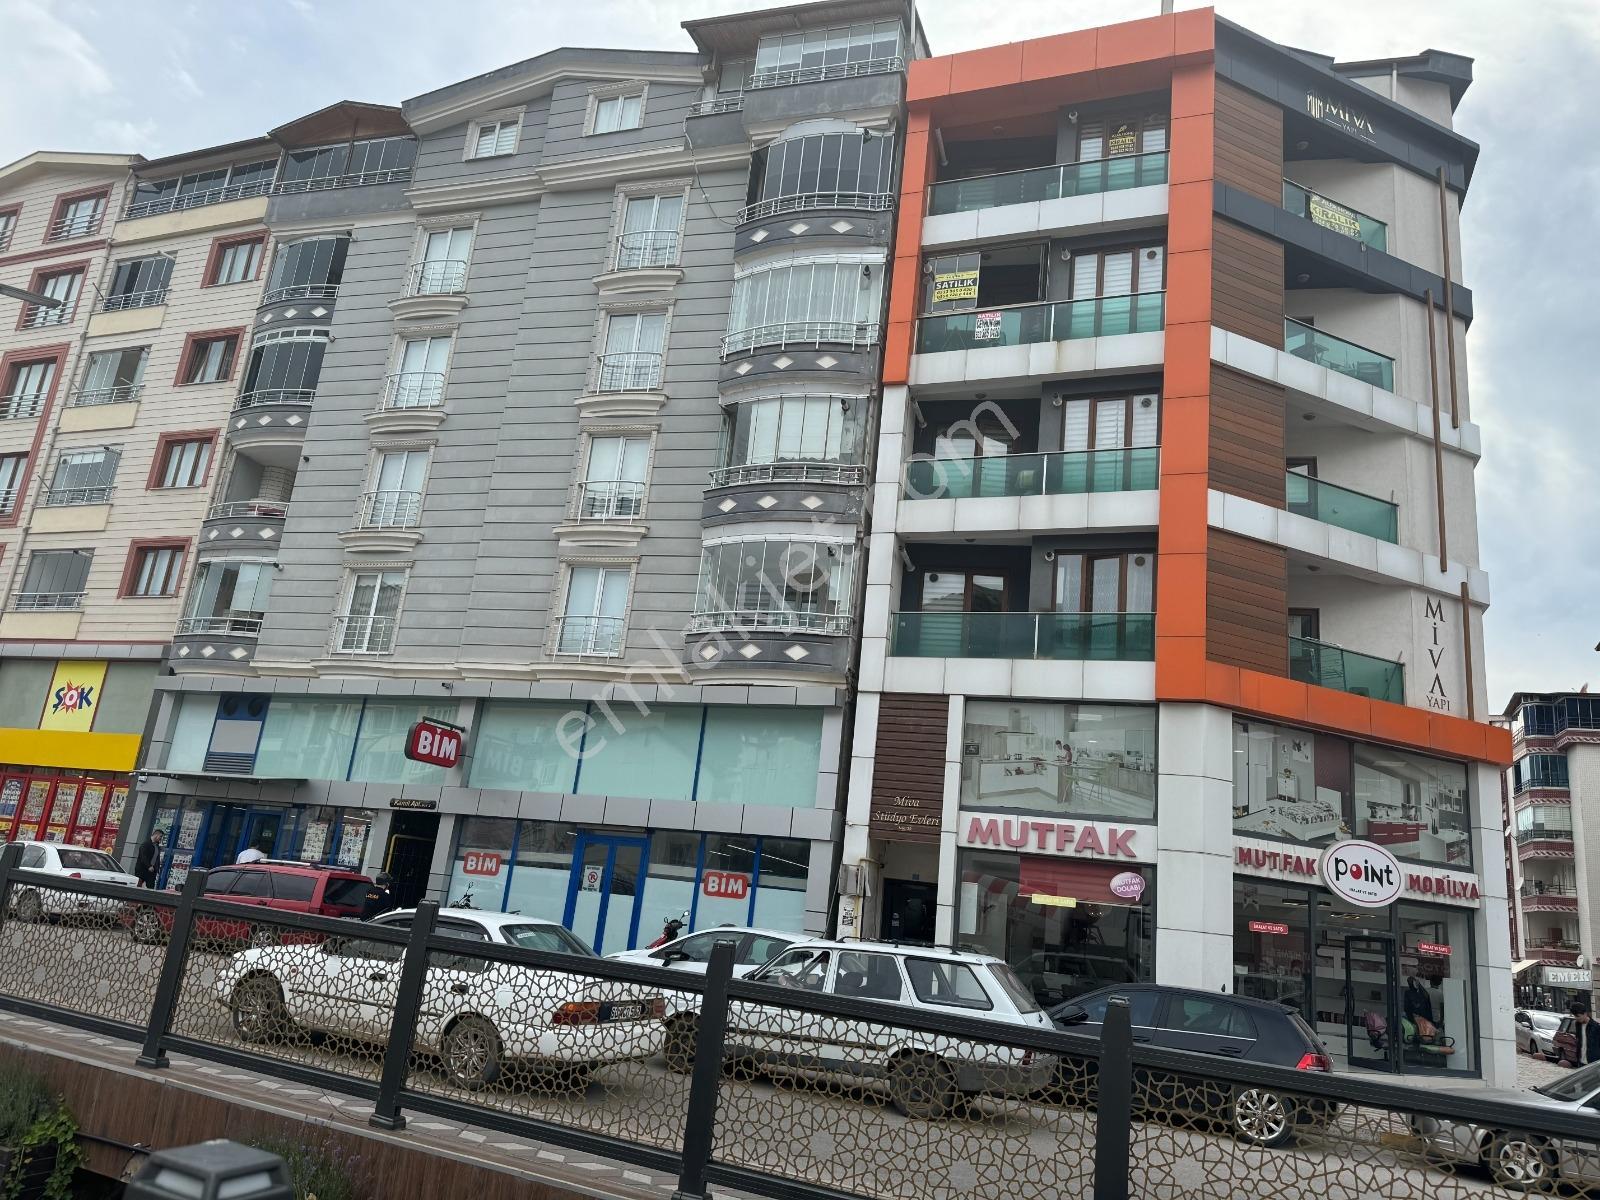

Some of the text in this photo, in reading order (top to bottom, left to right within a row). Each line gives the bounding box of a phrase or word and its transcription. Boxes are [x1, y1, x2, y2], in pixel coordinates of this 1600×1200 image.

[936, 279, 974, 290] SATILIK
[53, 686, 94, 715] ŞOK
[1426, 695, 1450, 711] YAPI
[417, 727, 458, 761] BİM
[893, 796, 920, 807] Miva
[873, 810, 941, 826] Stüdyo Evleri
[967, 817, 1137, 858] MUTFAK
[467, 852, 497, 872] BİM
[1237, 846, 1317, 876] MUTFAK
[707, 872, 743, 895] BİM
[1408, 873, 1480, 899] MOBİLYA
[1548, 971, 1590, 982] EMEK
